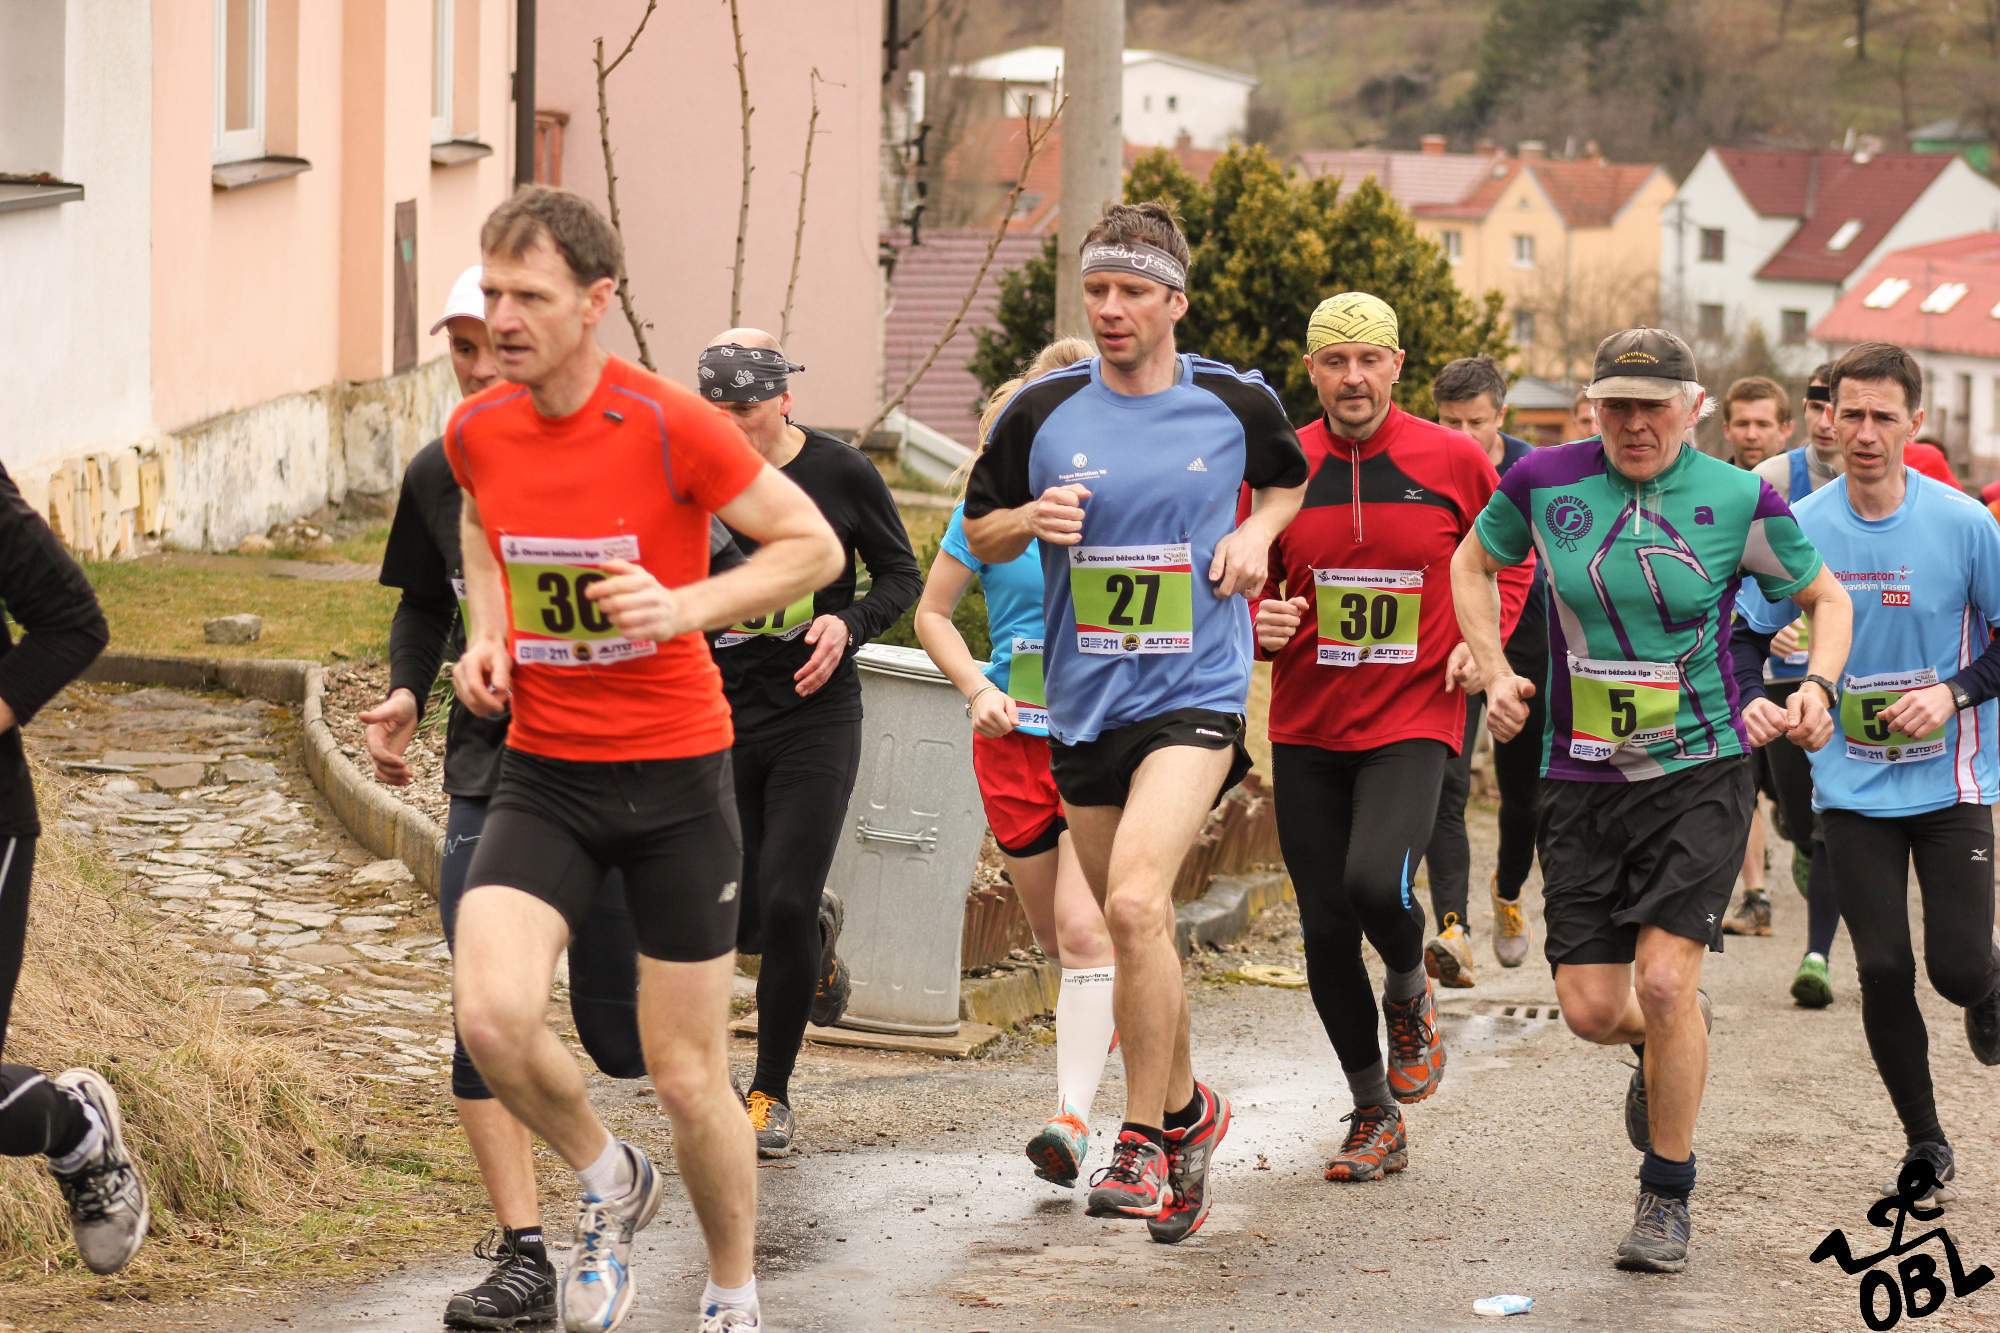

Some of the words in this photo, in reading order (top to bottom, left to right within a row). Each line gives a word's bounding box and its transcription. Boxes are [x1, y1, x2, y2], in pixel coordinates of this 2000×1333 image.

[1146, 554, 1160, 563] liga
[1881, 581, 1911, 591] krasem
[1106, 574, 1160, 626] 27
[1882, 592, 1909, 605] 2012
[1340, 593, 1398, 641] 30
[1103, 638, 1118, 649] 211
[1341, 651, 1356, 662] 211
[1638, 668, 1651, 677] liga
[1608, 689, 1637, 738] 5
[1594, 747, 1612, 757] 211
[1869, 751, 1884, 760] 211
